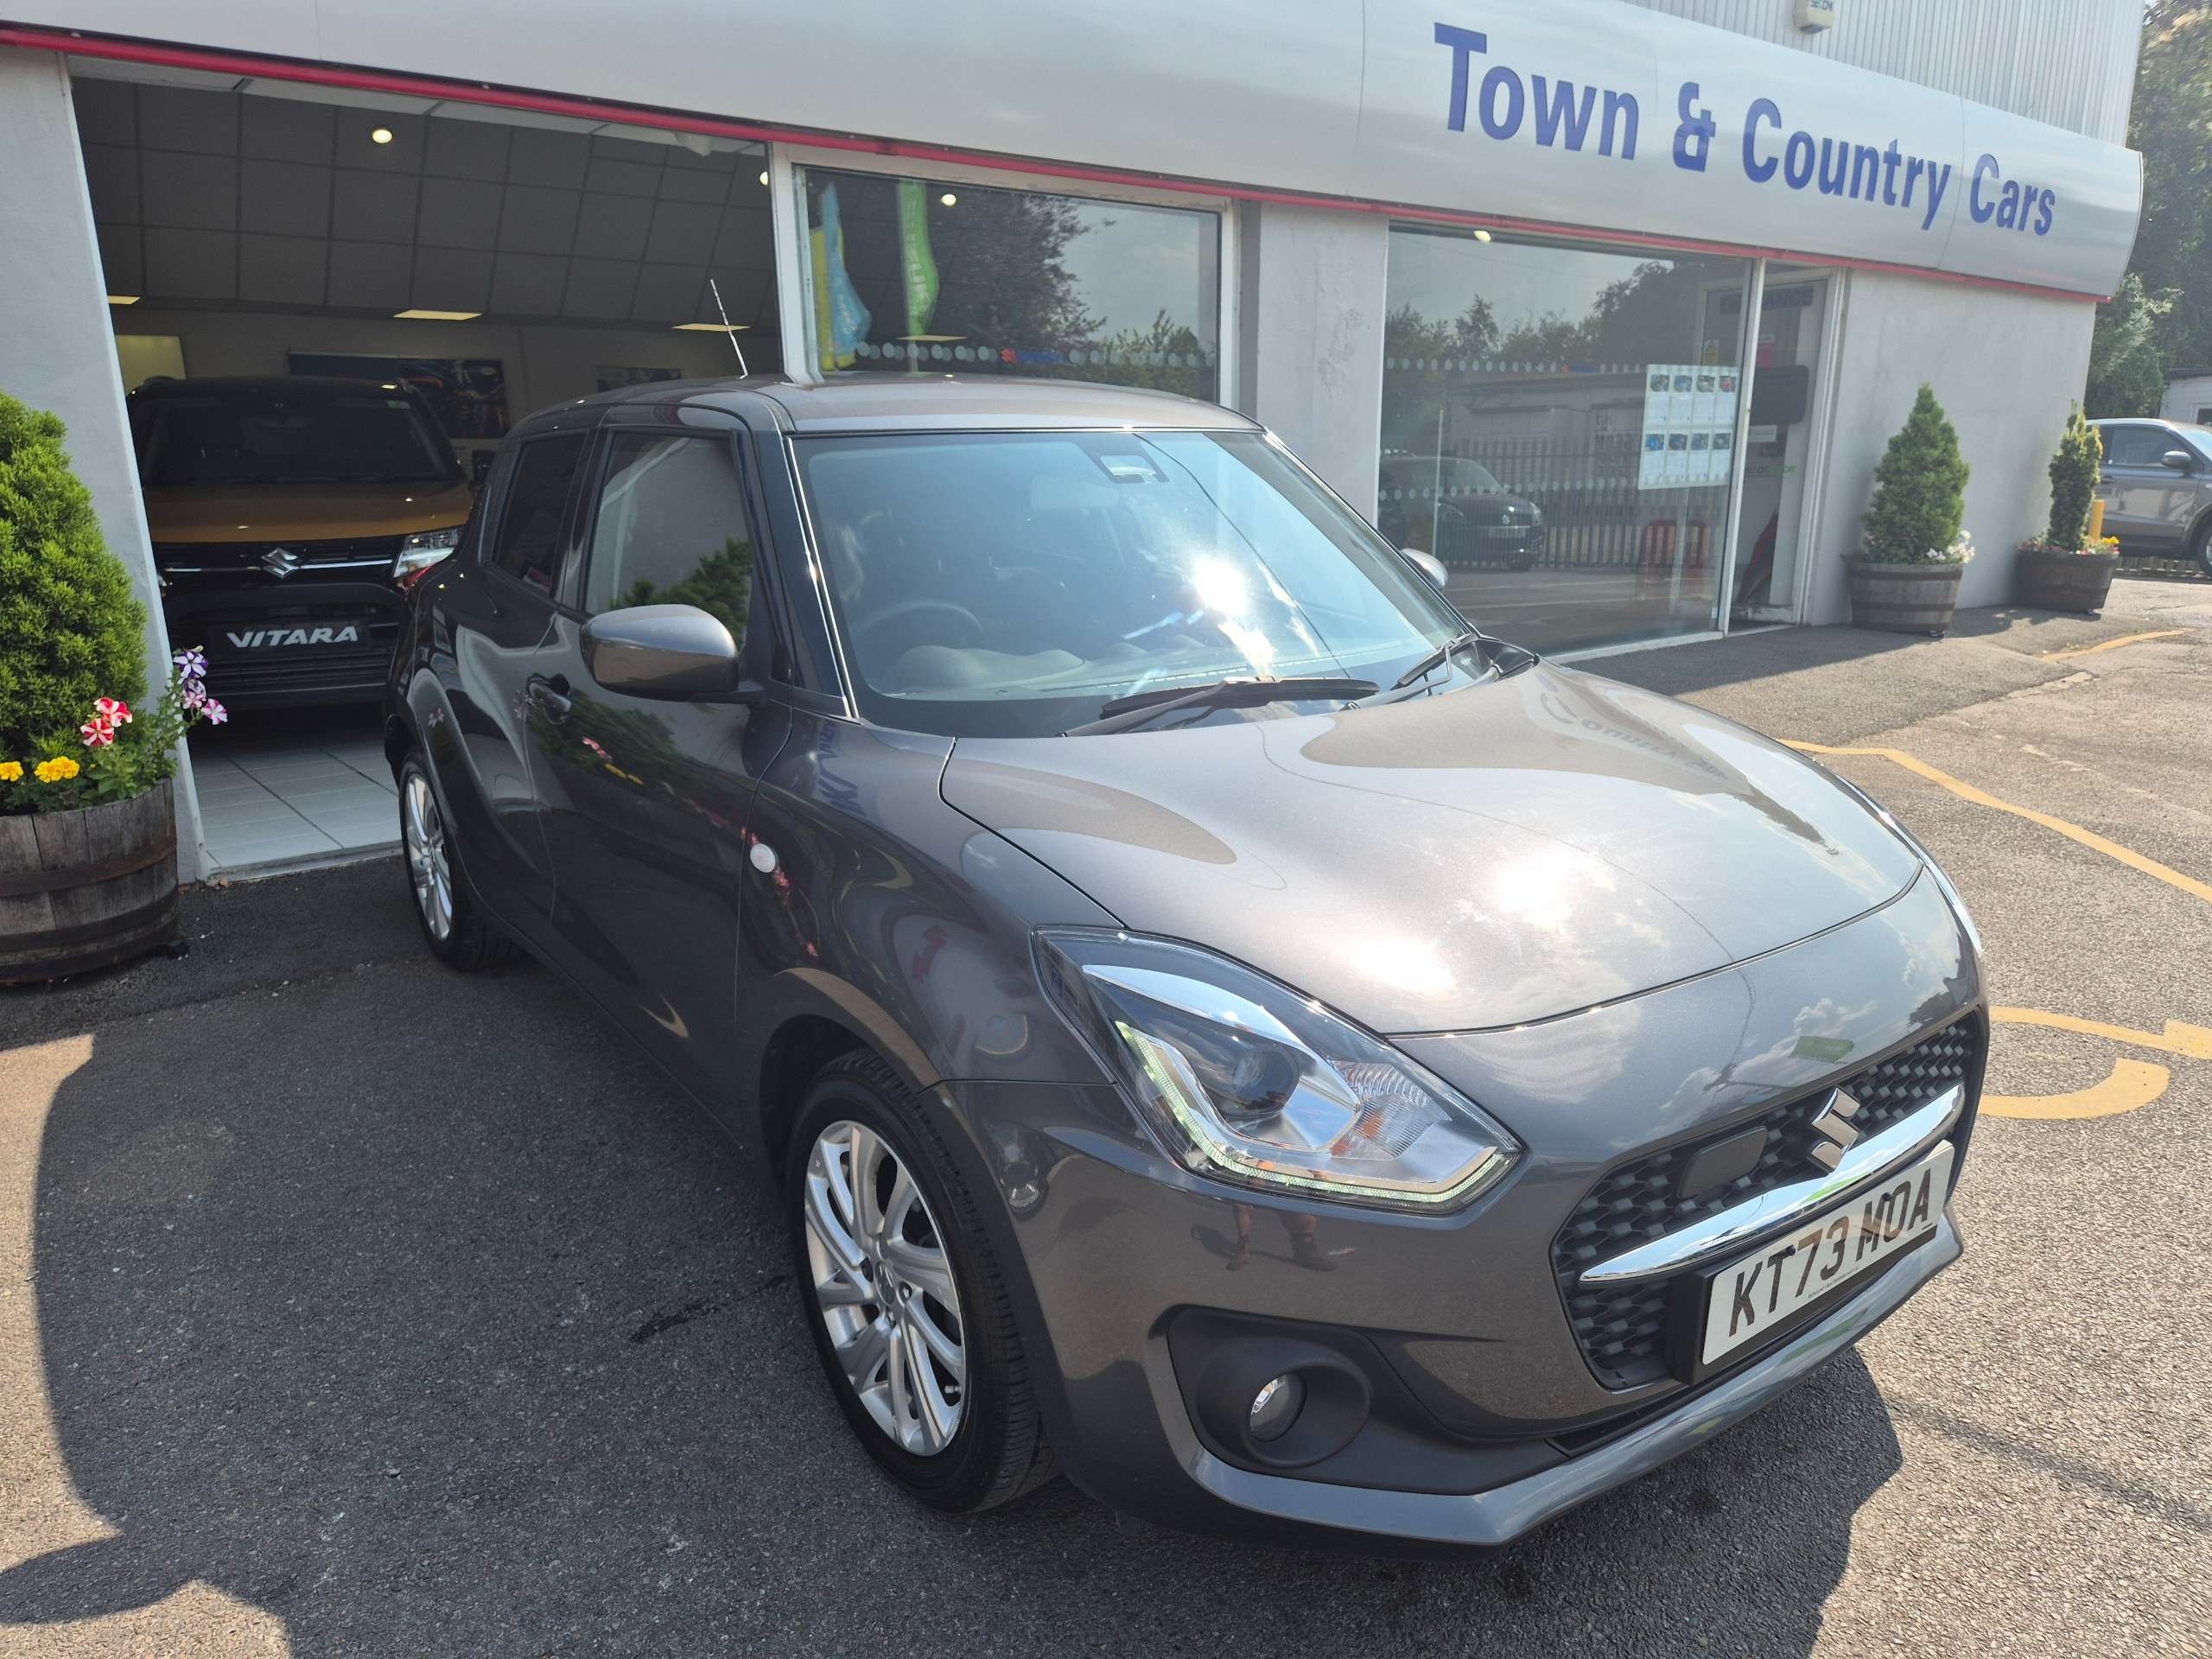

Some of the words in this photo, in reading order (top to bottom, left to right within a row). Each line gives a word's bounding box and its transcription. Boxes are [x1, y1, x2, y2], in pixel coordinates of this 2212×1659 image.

[1434, 22, 1639, 161] Town
[1673, 82, 1715, 172] &
[1742, 99, 1951, 230] Country
[1969, 154, 2056, 237] Cars
[226, 625, 359, 648] VITARA
[1729, 1215, 1851, 1338] KT73
[1855, 1167, 1932, 1262] MOA
